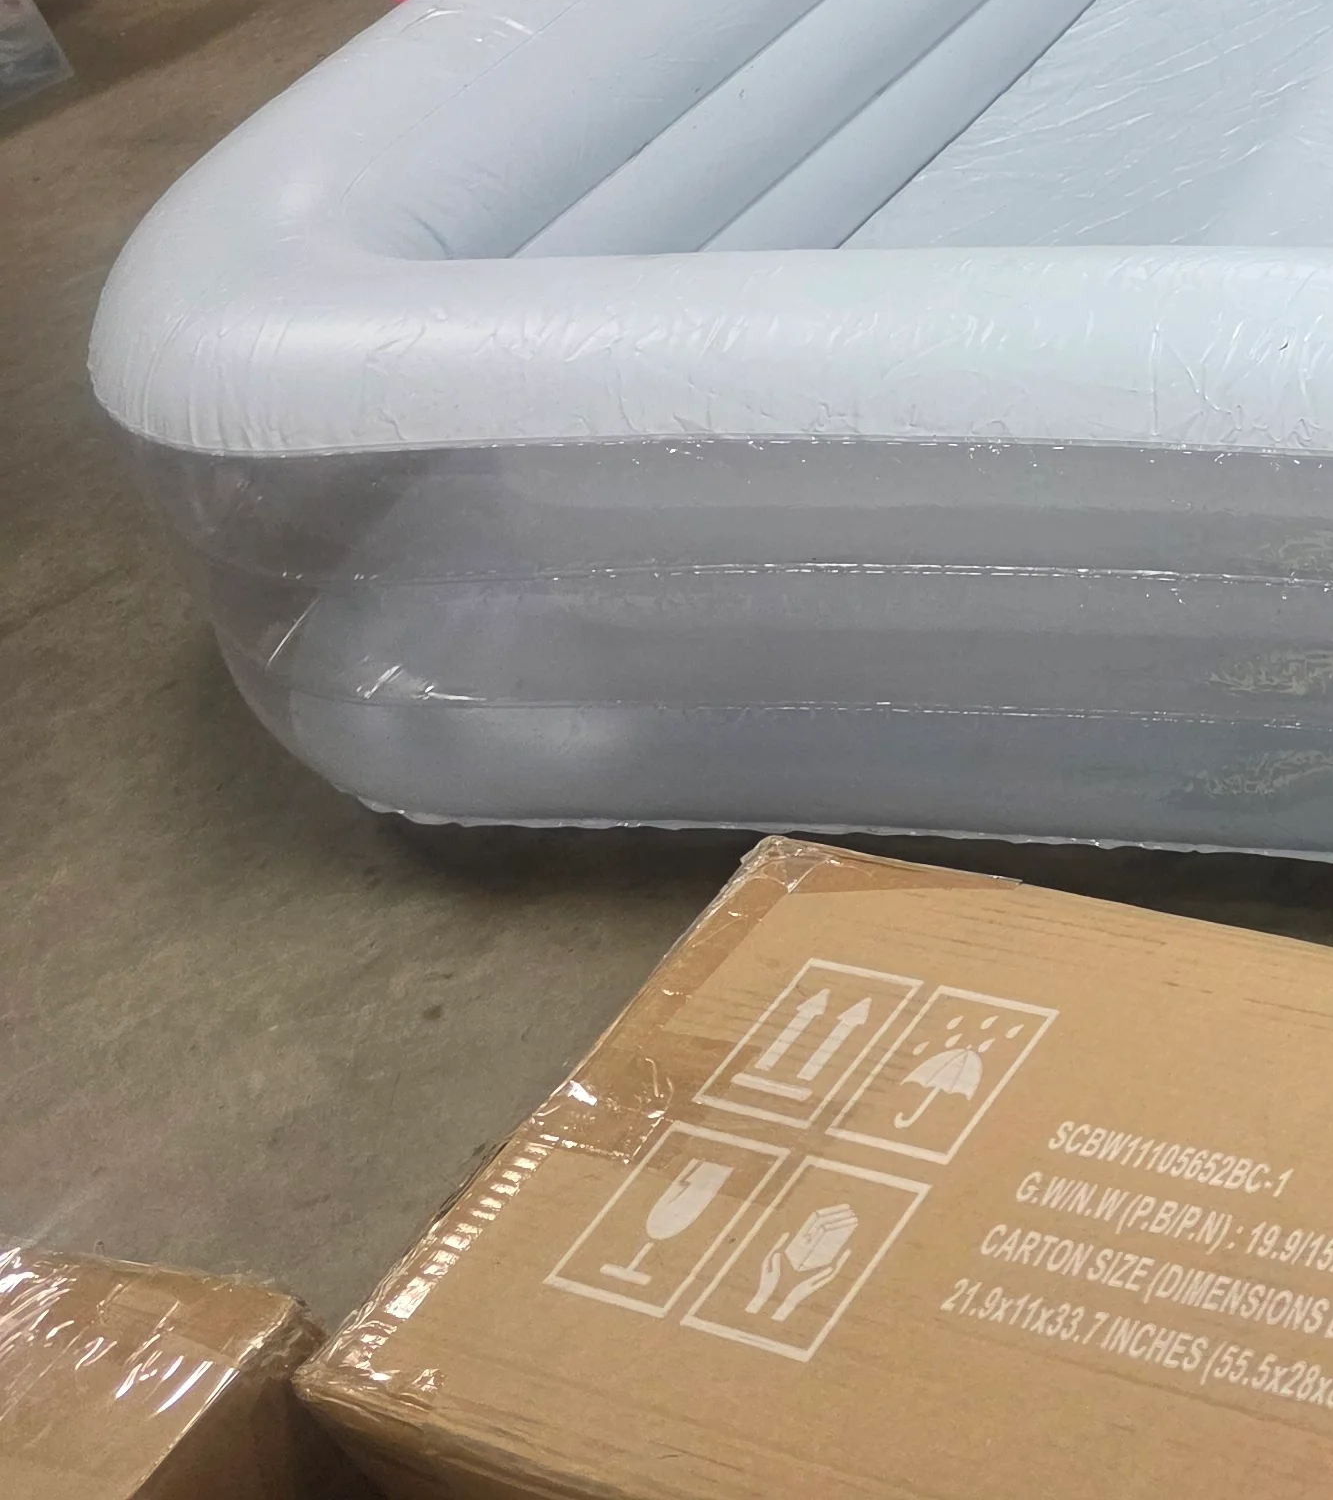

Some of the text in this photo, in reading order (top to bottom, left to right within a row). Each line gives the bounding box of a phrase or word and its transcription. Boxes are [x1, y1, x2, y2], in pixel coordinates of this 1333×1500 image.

[1015, 1171, 1130, 1222] G.W/N.W
[1048, 1120, 1295, 1197] SCBW11105652BC-1
[980, 1224, 1094, 1276] CARTON
[1087, 1248, 1155, 1292] SIZE
[1143, 1261, 1329, 1334] (DIMENSIONS
[940, 1278, 1110, 1345] 21.9x11x33.7
[1100, 1315, 1211, 1372] INCHES
